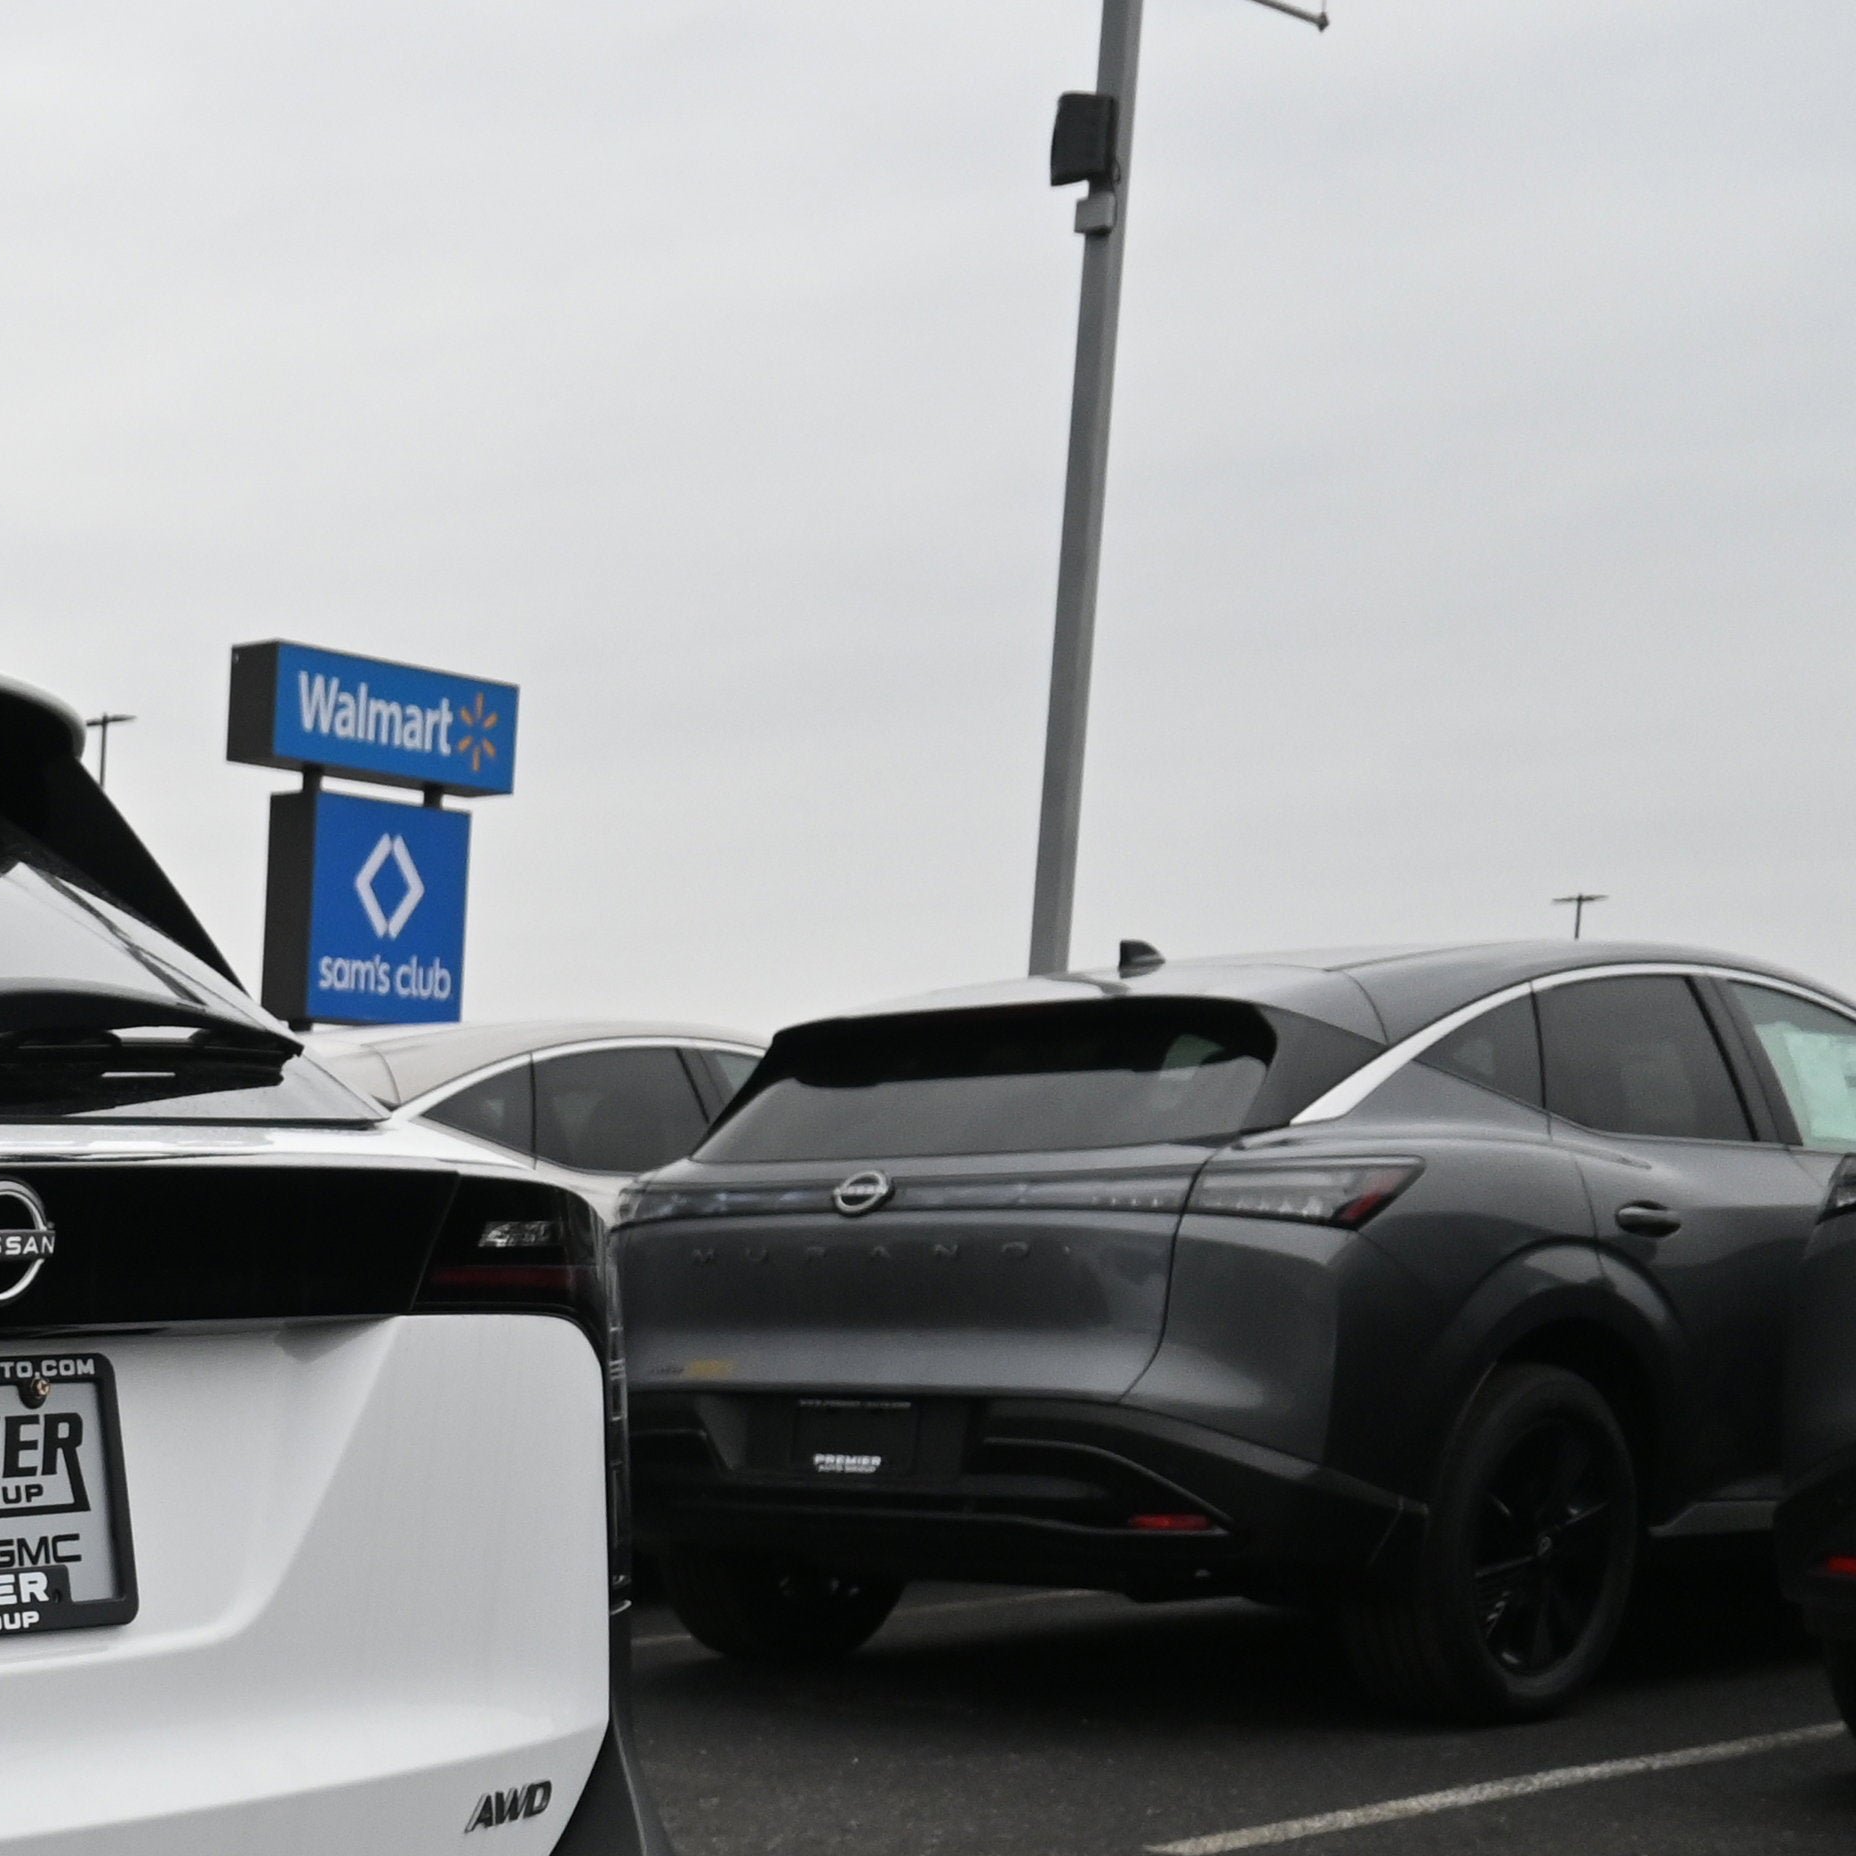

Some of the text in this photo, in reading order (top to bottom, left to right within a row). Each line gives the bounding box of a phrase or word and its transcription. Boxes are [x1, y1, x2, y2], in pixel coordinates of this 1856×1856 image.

[298, 670, 454, 757] Walmart
[318, 955, 452, 1000] sam's club
[464, 1780, 552, 1833] AWD
